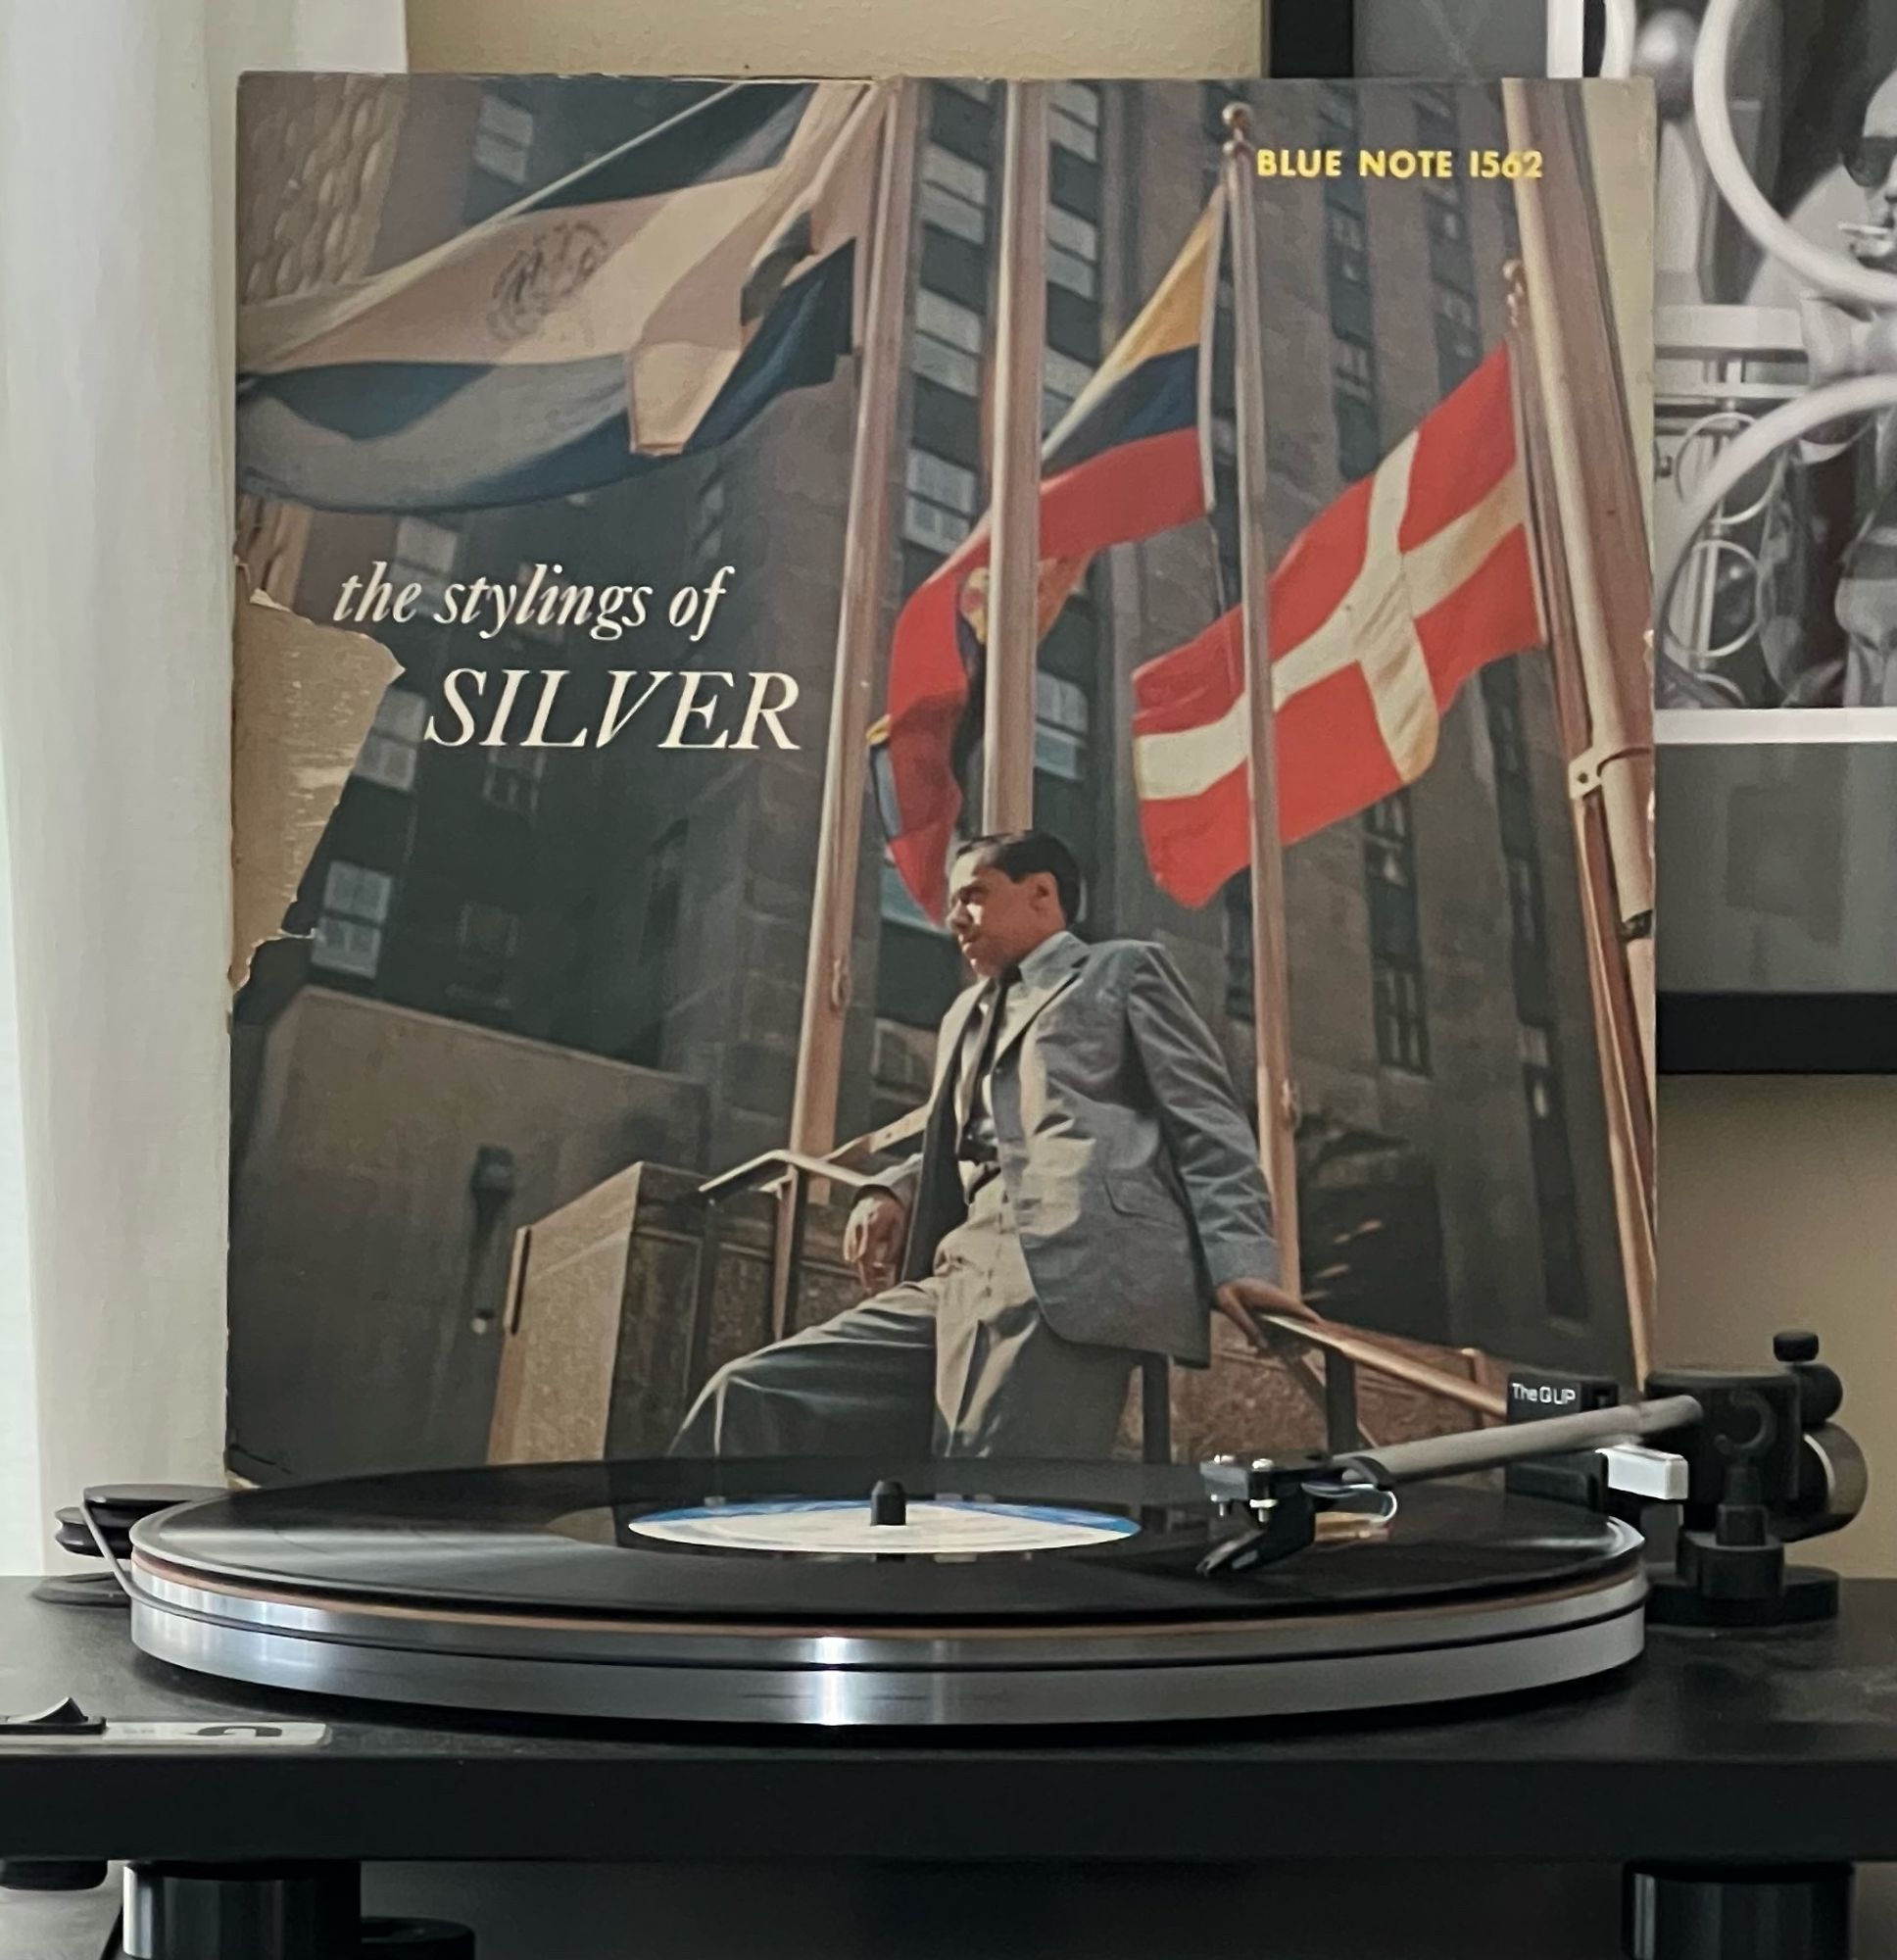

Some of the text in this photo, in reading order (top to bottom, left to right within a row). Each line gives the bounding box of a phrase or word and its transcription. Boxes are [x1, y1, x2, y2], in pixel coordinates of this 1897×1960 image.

[1257, 149, 1542, 178] BLUE NOTE 1562
[333, 562, 735, 642] the stylings of
[424, 667, 801, 750] SILVER
